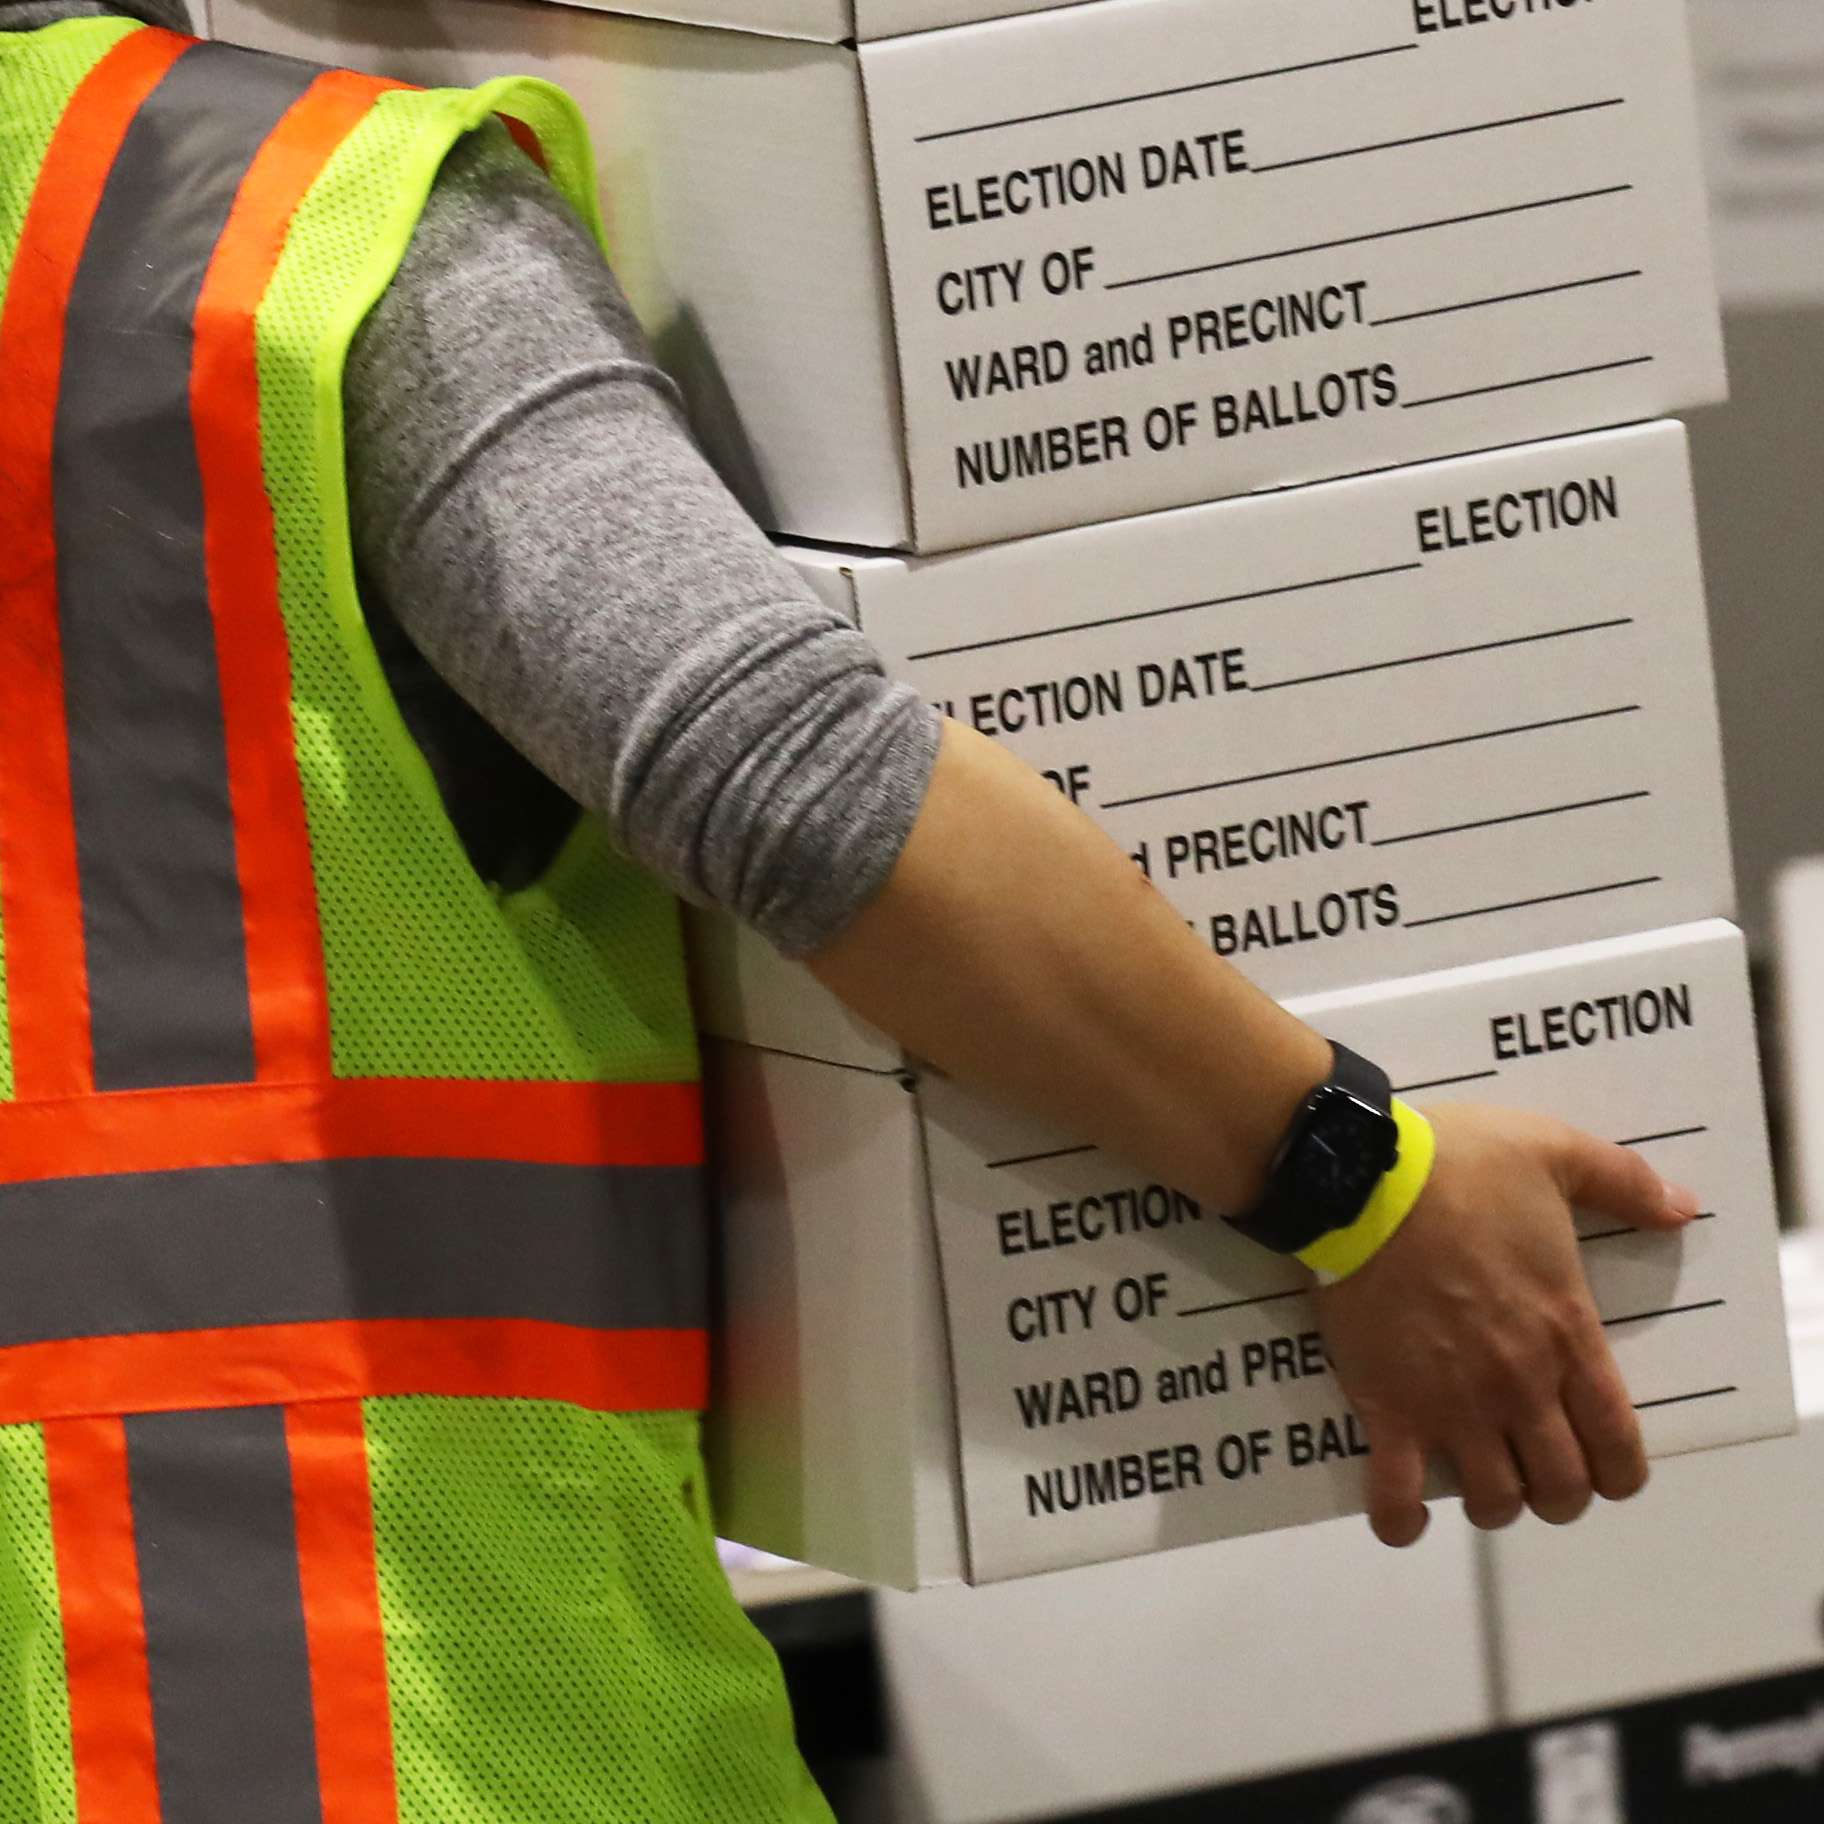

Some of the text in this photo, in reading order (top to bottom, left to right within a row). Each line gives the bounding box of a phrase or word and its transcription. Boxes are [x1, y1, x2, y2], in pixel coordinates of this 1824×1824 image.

[925, 129, 1249, 230] ELECTION DATE
[937, 246, 1094, 316] CITY OF
[944, 280, 1367, 401] WARD and PRECINCT
[955, 363, 1397, 489] NUMBER OF BALLOTS
[1416, 475, 1618, 553] ELECTION
[930, 647, 1247, 737] ECTION DATE
[1165, 800, 1369, 879] PRECINCT
[1210, 883, 1399, 957] BALLOTS
[1491, 983, 1692, 1061] ELECTION
[997, 1183, 1202, 1256] ELECTION
[1007, 1272, 1168, 1343] CITY OF
[1014, 1331, 1334, 1429] WARD and PRE
[1026, 1412, 1372, 1517] NUMBER OF BAL
